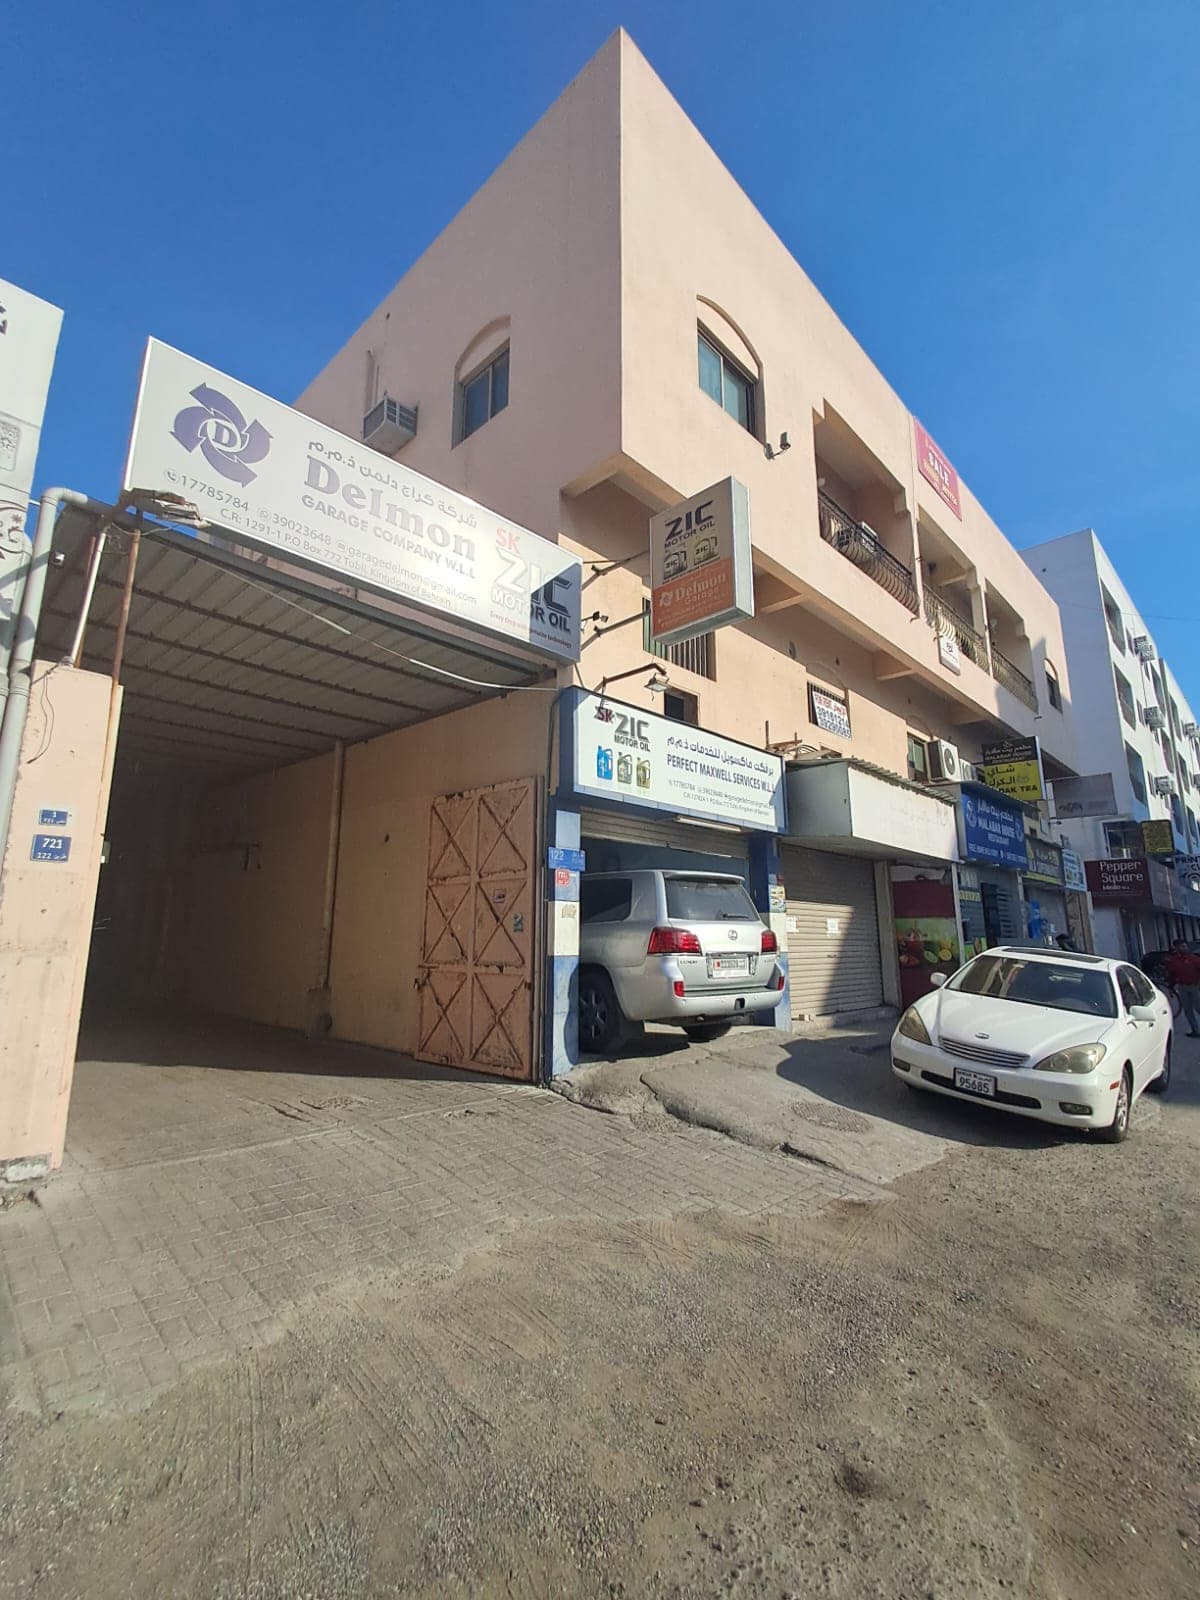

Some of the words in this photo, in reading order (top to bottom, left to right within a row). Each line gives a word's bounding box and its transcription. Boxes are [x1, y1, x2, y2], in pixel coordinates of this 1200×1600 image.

[212, 421, 238, 448] D
[359, 465, 399, 490] دلمن
[304, 454, 477, 562] Delmon
[401, 484, 435, 507] كراج
[181, 474, 249, 512] 17785784
[272, 512, 332, 546] 39023648
[438, 500, 478, 529] شركة
[664, 500, 714, 541] ZIC
[301, 494, 369, 532] GARAGE
[373, 526, 442, 564] COMPANY
[496, 526, 521, 558] SK
[664, 529, 697, 548] MOTOR
[699, 520, 716, 532] OIL
[303, 540, 321, 554] Box
[494, 547, 573, 618] ZIC
[674, 572, 727, 601] Delmon
[491, 585, 546, 625] MOTOR
[548, 612, 572, 634] OIL
[596, 707, 614, 725] SK
[615, 711, 650, 743] ZIC
[614, 734, 639, 749] MOTOR
[640, 741, 651, 753] OIL
[667, 753, 699, 774] PERFECT
[699, 762, 732, 783] MAXWELL
[733, 772, 761, 790] SERVICES
[986, 764, 1015, 778] شاي
[1019, 784, 1038, 793] TEA
[1099, 861, 1142, 873] Pepper
[1101, 872, 1144, 884] Square
[960, 1076, 990, 1093] 95685
